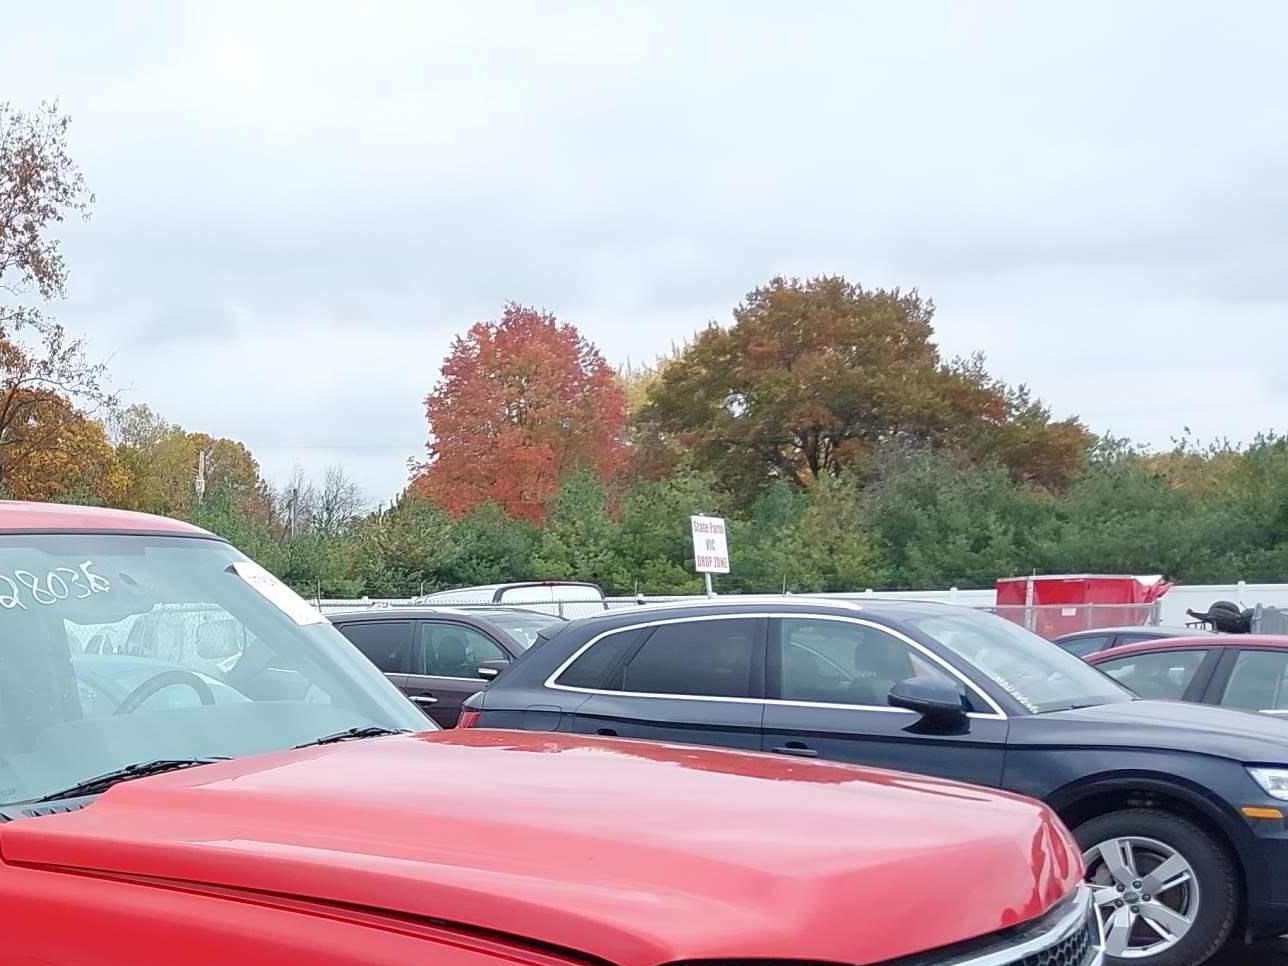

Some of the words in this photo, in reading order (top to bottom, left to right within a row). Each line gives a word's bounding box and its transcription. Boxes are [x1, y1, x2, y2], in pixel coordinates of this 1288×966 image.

[693, 520, 709, 533] State
[710, 522, 724, 534] Farm
[697, 555, 712, 568] DROP
[713, 556, 728, 569] ZONE
